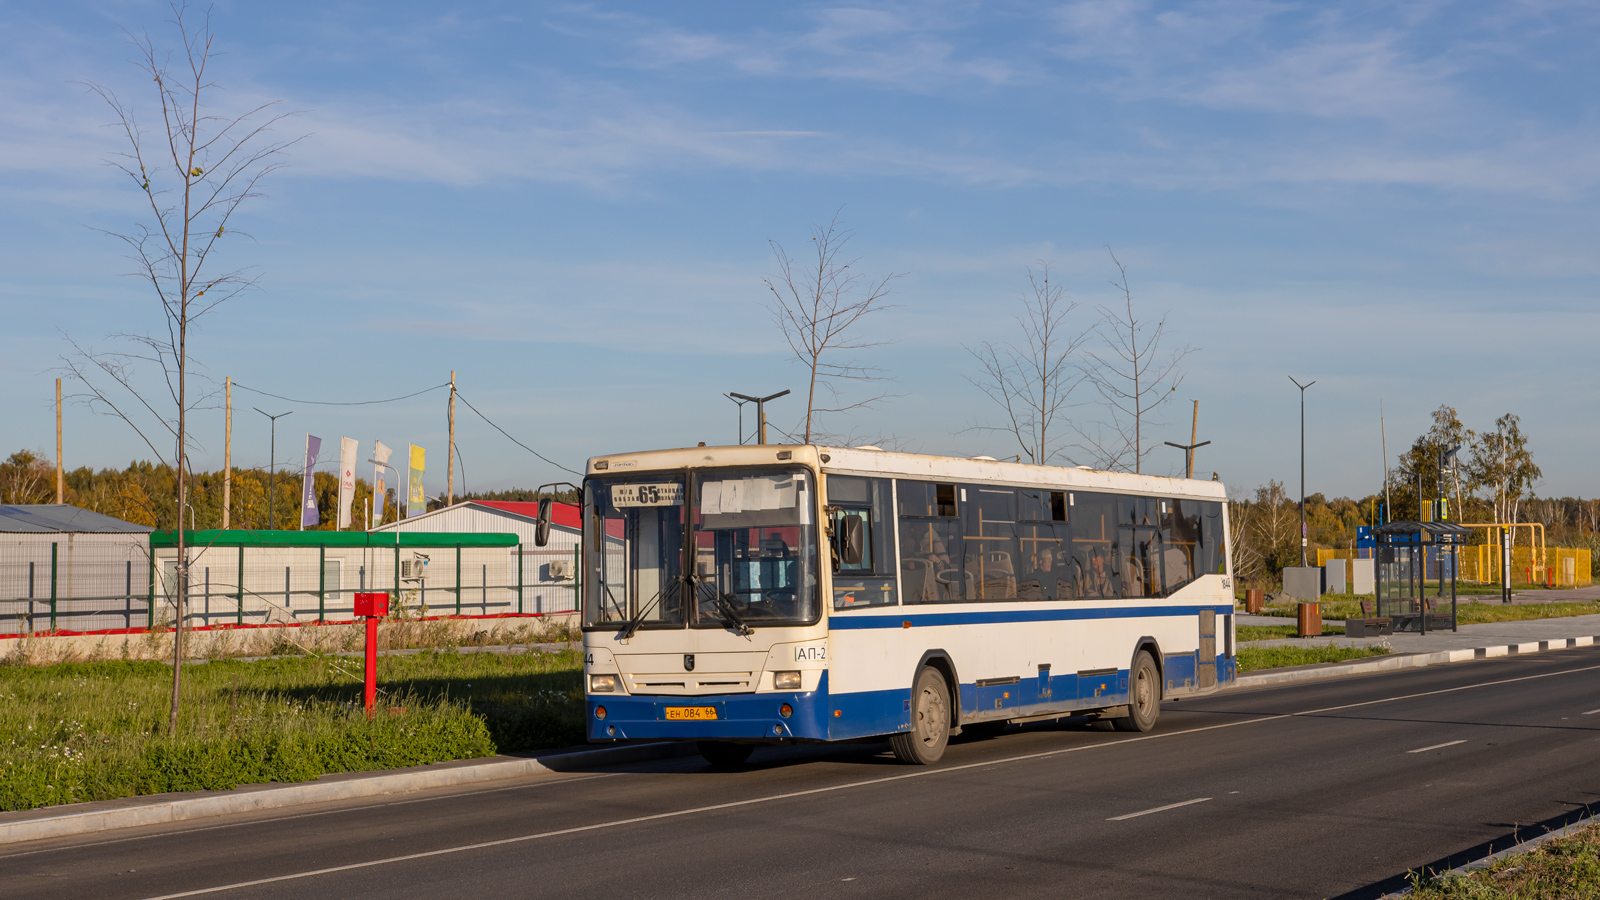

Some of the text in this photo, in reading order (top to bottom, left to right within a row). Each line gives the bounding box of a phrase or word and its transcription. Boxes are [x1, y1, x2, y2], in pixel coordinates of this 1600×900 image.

[638, 485, 659, 504] 65
[797, 647, 826, 660] АП-2
[684, 708, 700, 718] 084
[705, 707, 714, 716] 66
